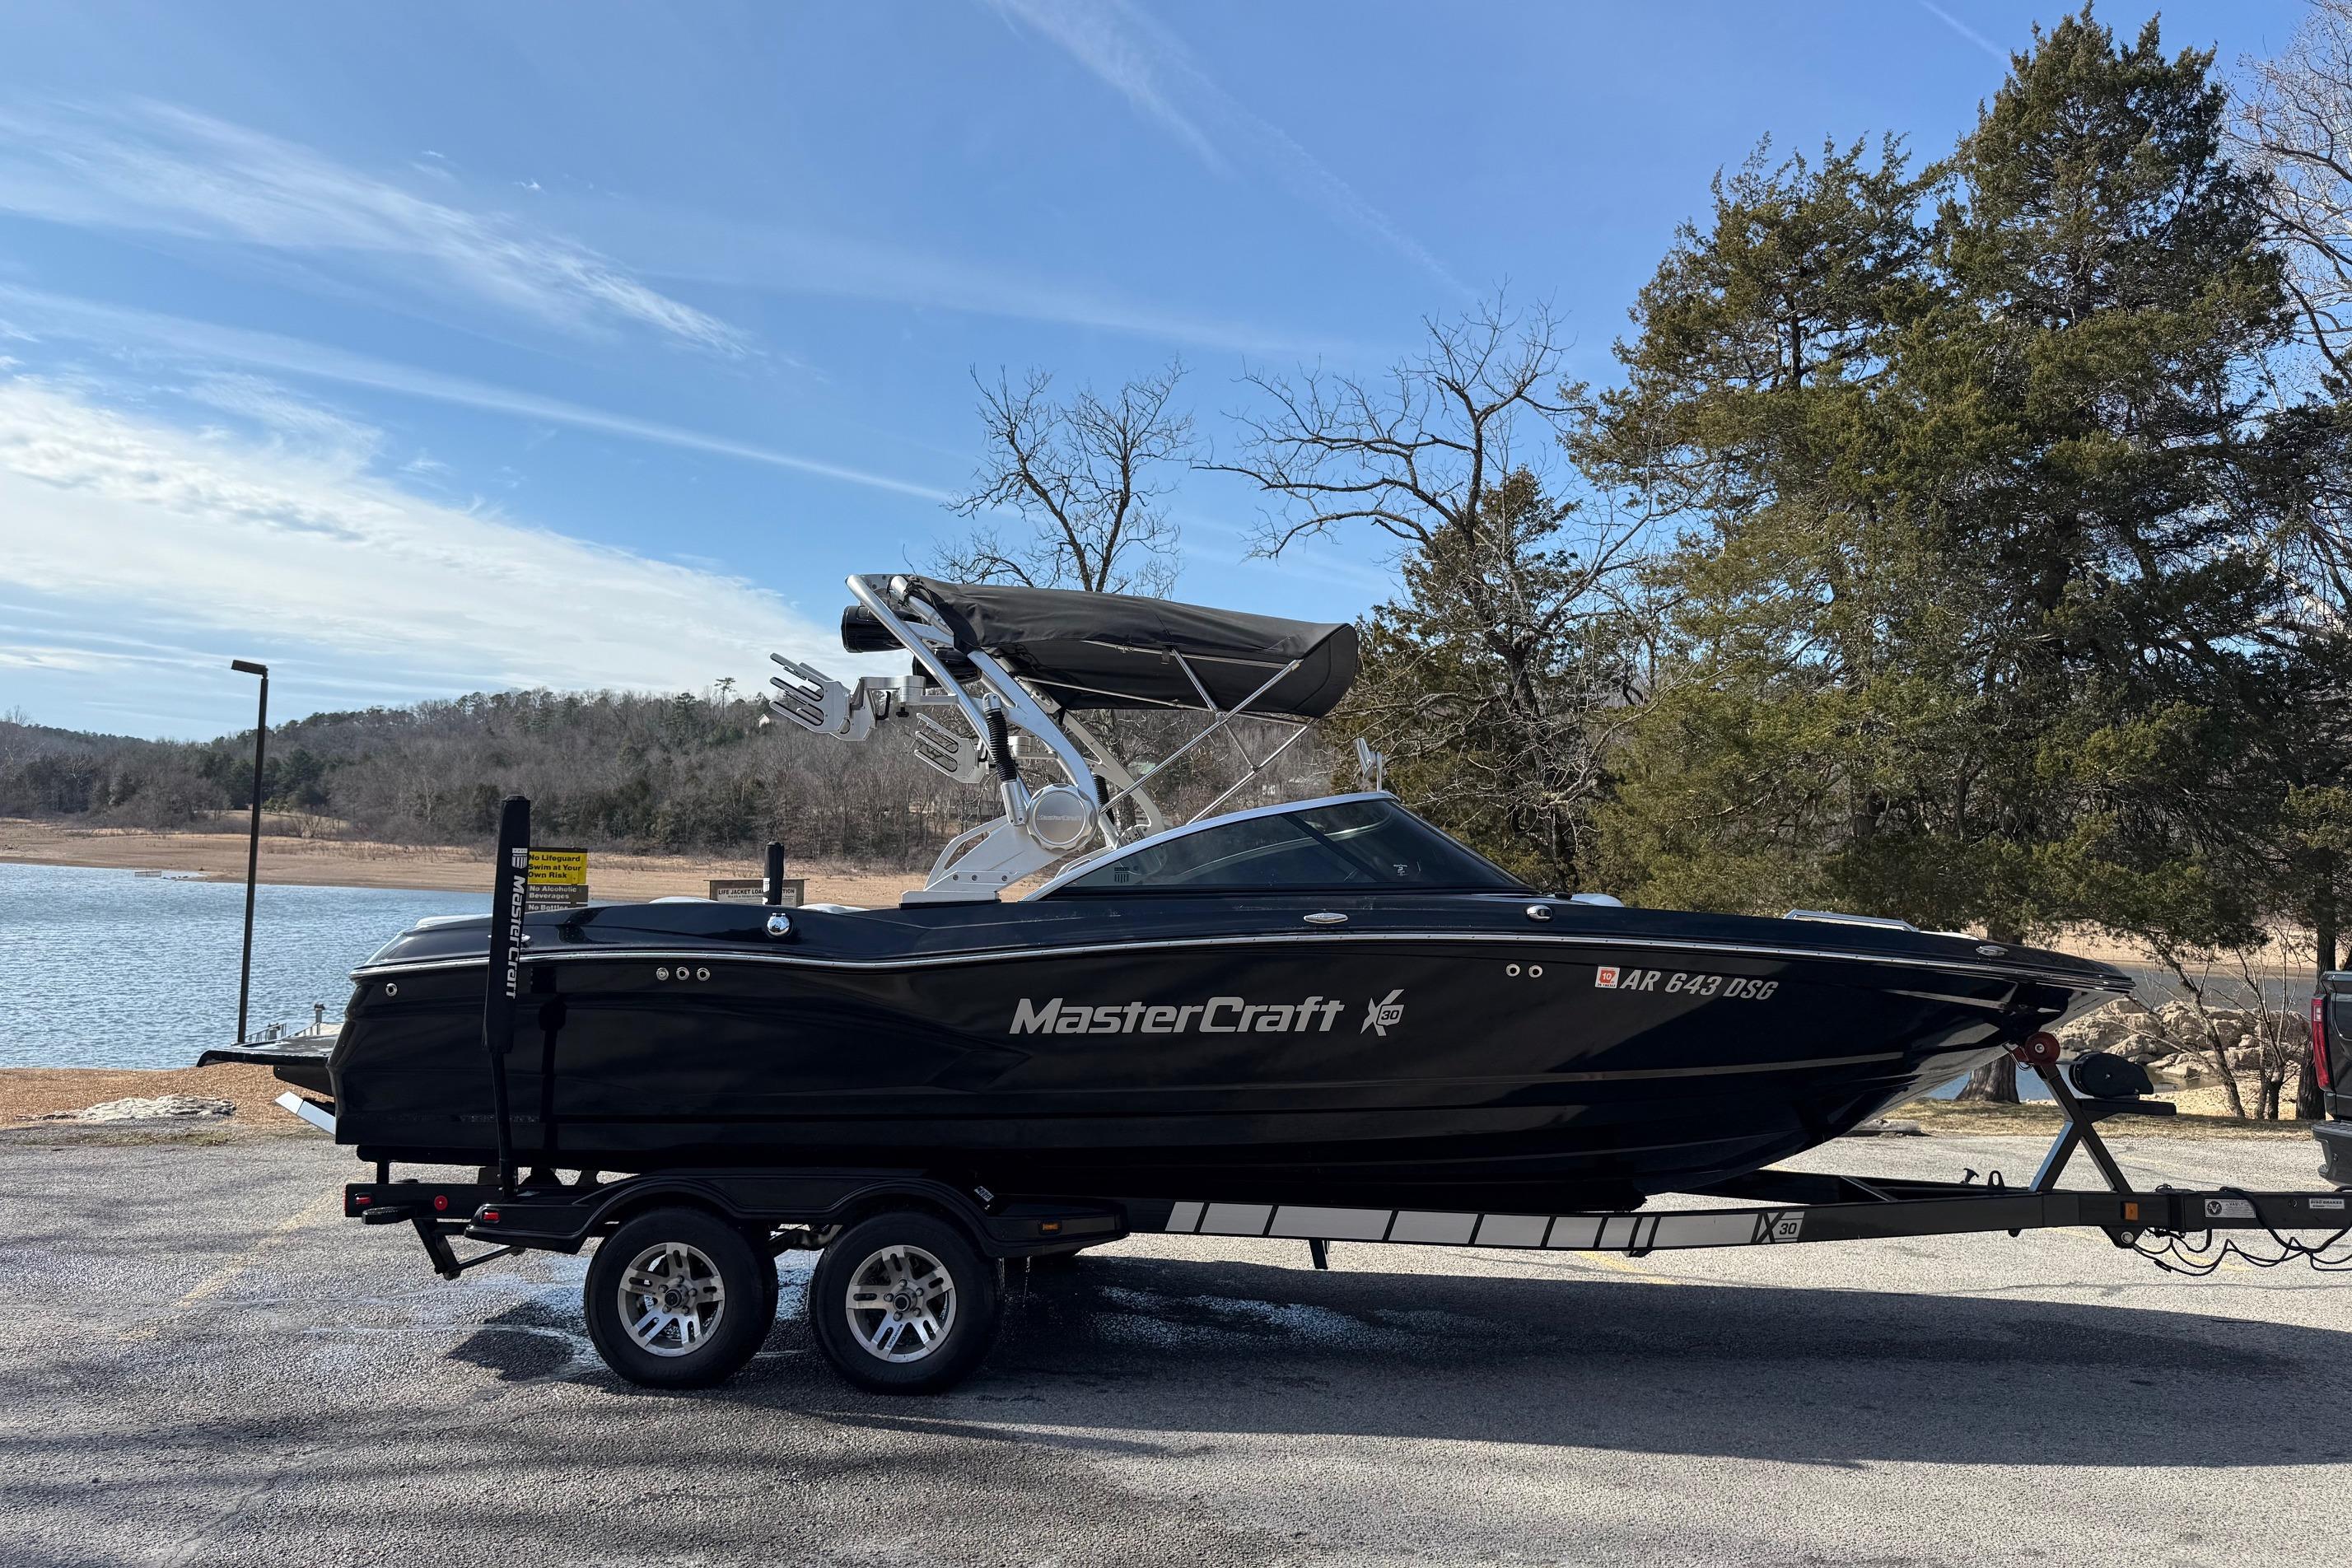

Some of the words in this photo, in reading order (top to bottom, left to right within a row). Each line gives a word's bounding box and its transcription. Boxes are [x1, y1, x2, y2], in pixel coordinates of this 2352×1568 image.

[541, 854, 581, 863] Lifeguard
[528, 863, 552, 871] Swim
[548, 871, 567, 880] Risk
[541, 884, 577, 893] Alcoholic
[529, 892, 570, 900] Beverages
[528, 903, 539, 912] No
[506, 875, 526, 1000] MasterCraft
[1602, 973, 1612, 981] 10
[1619, 969, 1662, 992] AR
[1664, 973, 1723, 996] 643
[1723, 978, 1779, 1001] DSG
[1009, 996, 1346, 1034] MasterCraft
